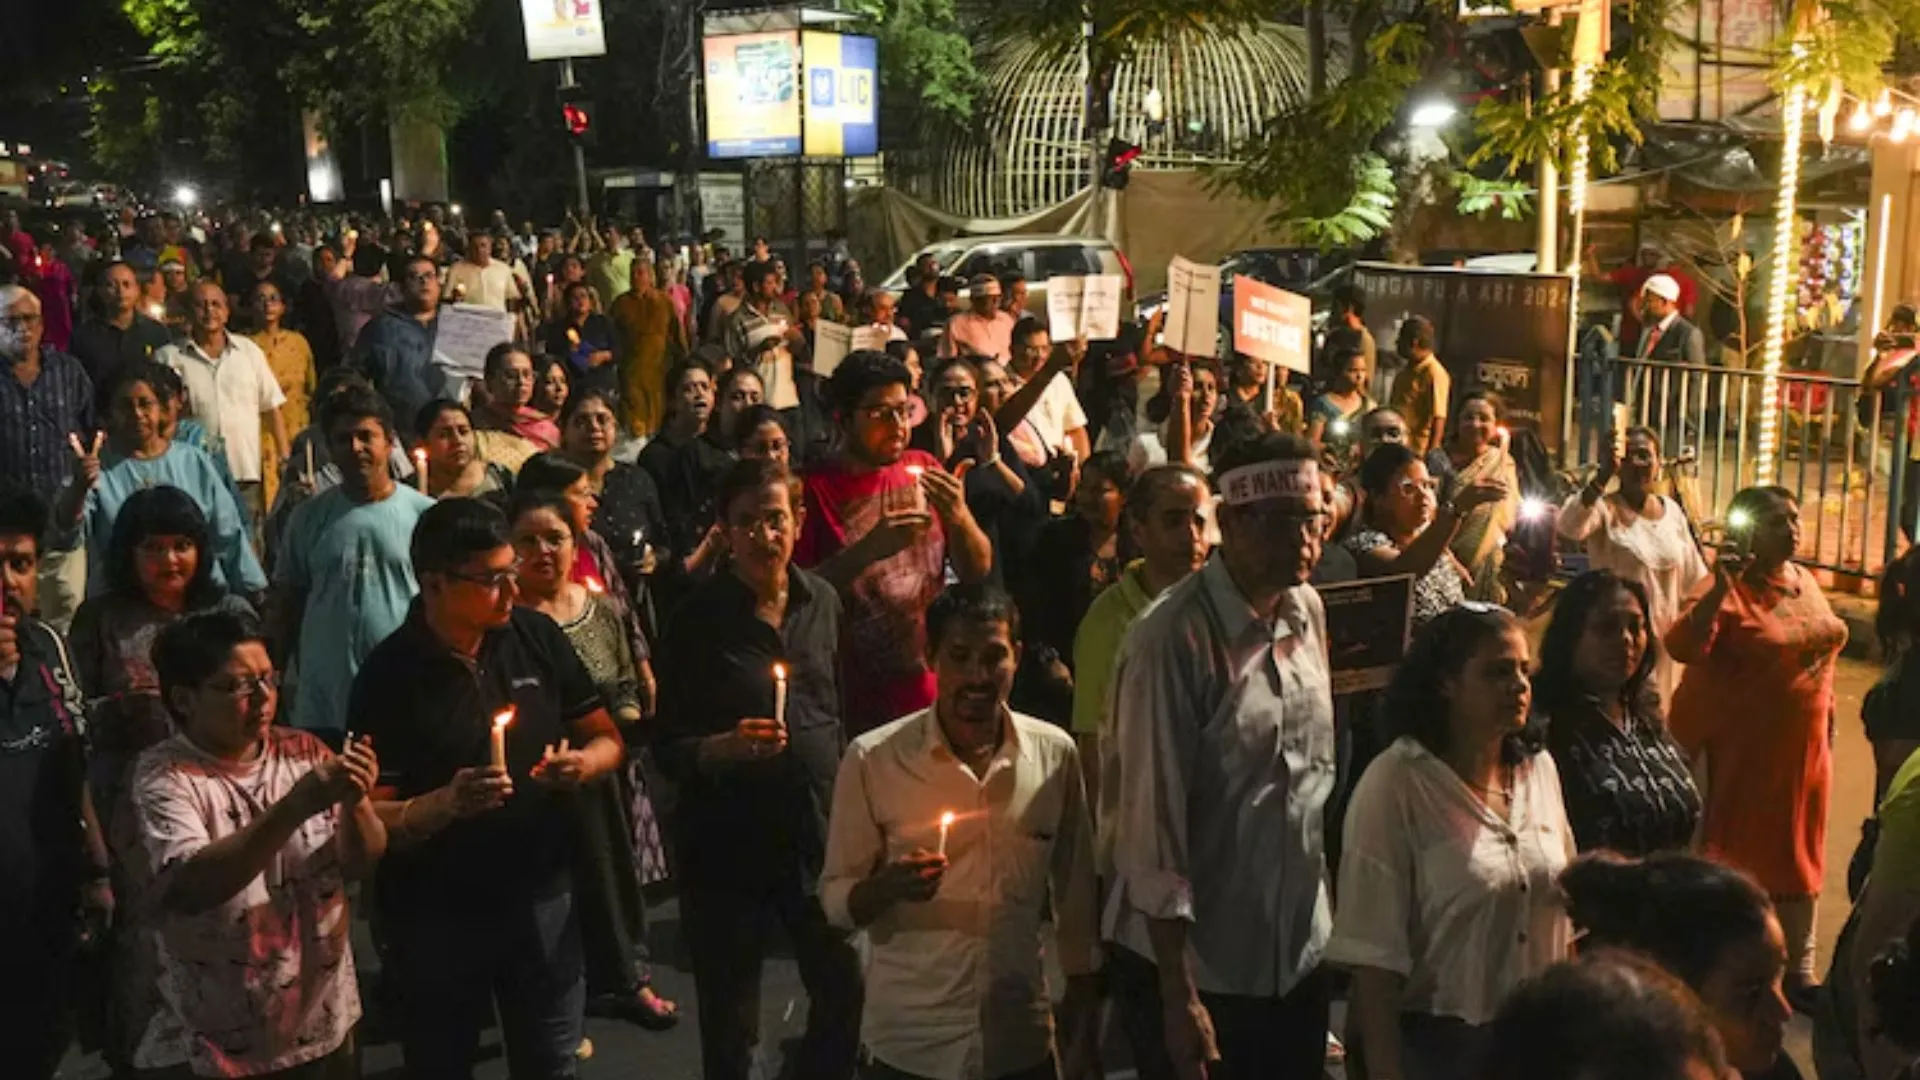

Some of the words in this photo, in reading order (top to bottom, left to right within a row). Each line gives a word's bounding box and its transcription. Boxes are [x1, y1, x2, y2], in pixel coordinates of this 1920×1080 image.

[840, 74, 869, 105] LIC
[1423, 278, 1469, 299] PUA
[1480, 283, 1514, 304] ART
[1228, 475, 1249, 499] WE
[1252, 468, 1299, 494] WANT
